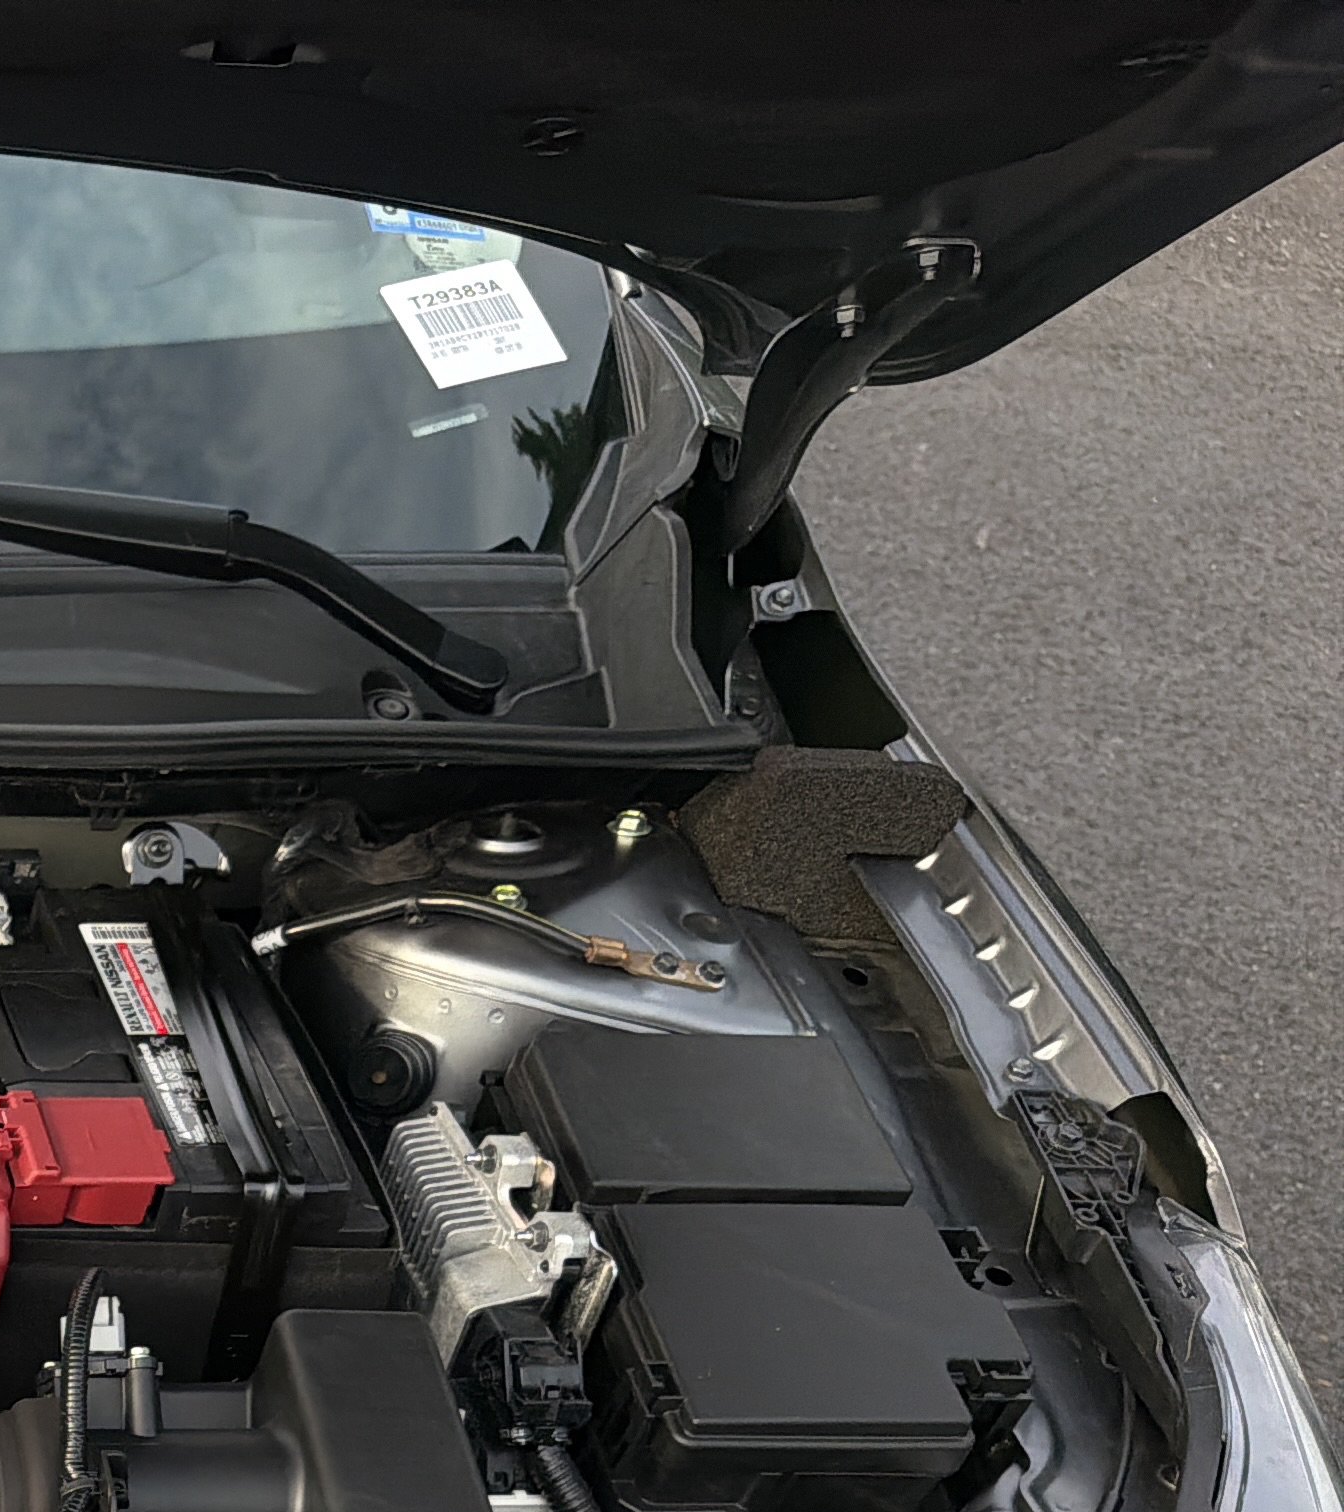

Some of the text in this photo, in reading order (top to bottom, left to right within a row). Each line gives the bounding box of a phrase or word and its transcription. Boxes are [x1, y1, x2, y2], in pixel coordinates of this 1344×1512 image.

[408, 279, 503, 309] T29383A
[93, 944, 123, 990] NISSAN
[116, 990, 144, 1033] RENAULT
